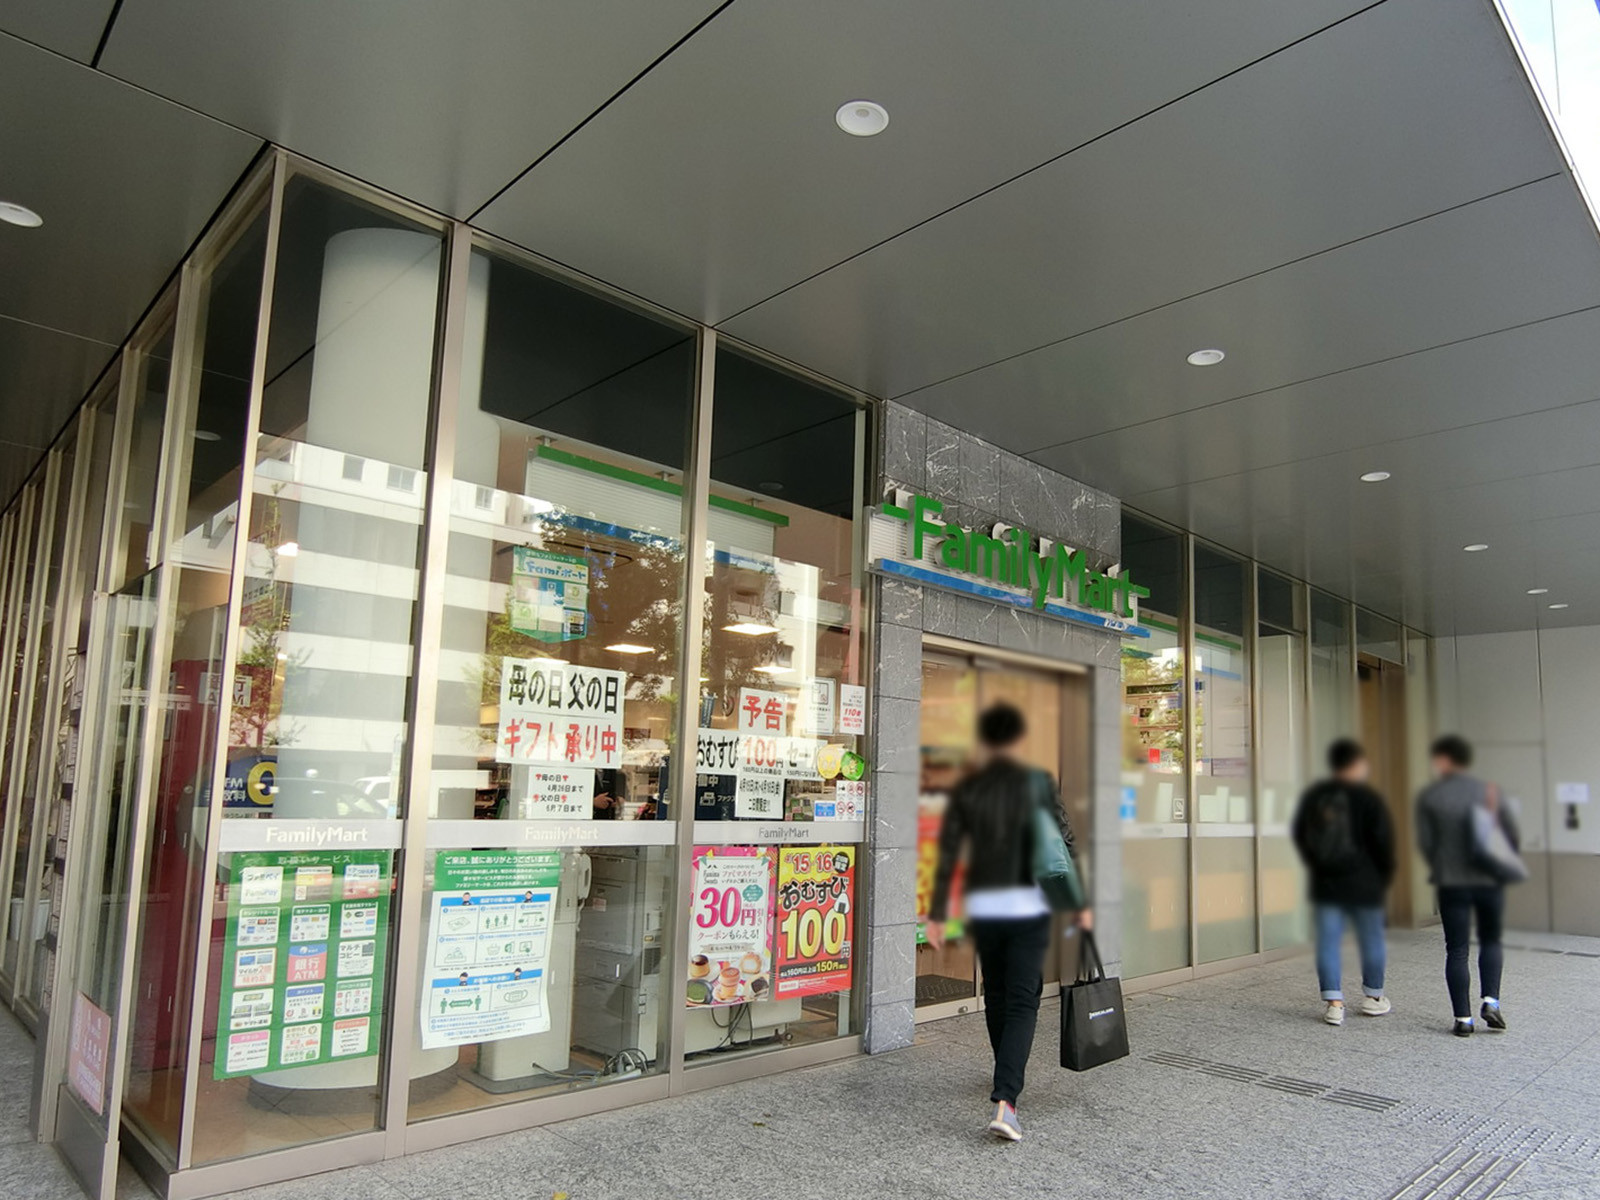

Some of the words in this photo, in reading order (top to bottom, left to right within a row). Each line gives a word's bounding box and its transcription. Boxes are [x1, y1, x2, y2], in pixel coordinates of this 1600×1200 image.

[881, 494, 1151, 618] FamilyMart
[742, 694, 784, 731] 予告
[504, 718, 617, 763] ギフト承り中
[696, 734, 740, 770] おむすび
[541, 773, 562, 783] 母の日
[540, 794, 560, 802] 父の日
[266, 827, 368, 846] FamilyMart
[525, 826, 599, 843] FamilyMart
[758, 827, 810, 841] FamilyMart
[780, 875, 850, 911] おむすび
[295, 957, 320, 970] 銀行
[294, 969, 320, 981] ATM
